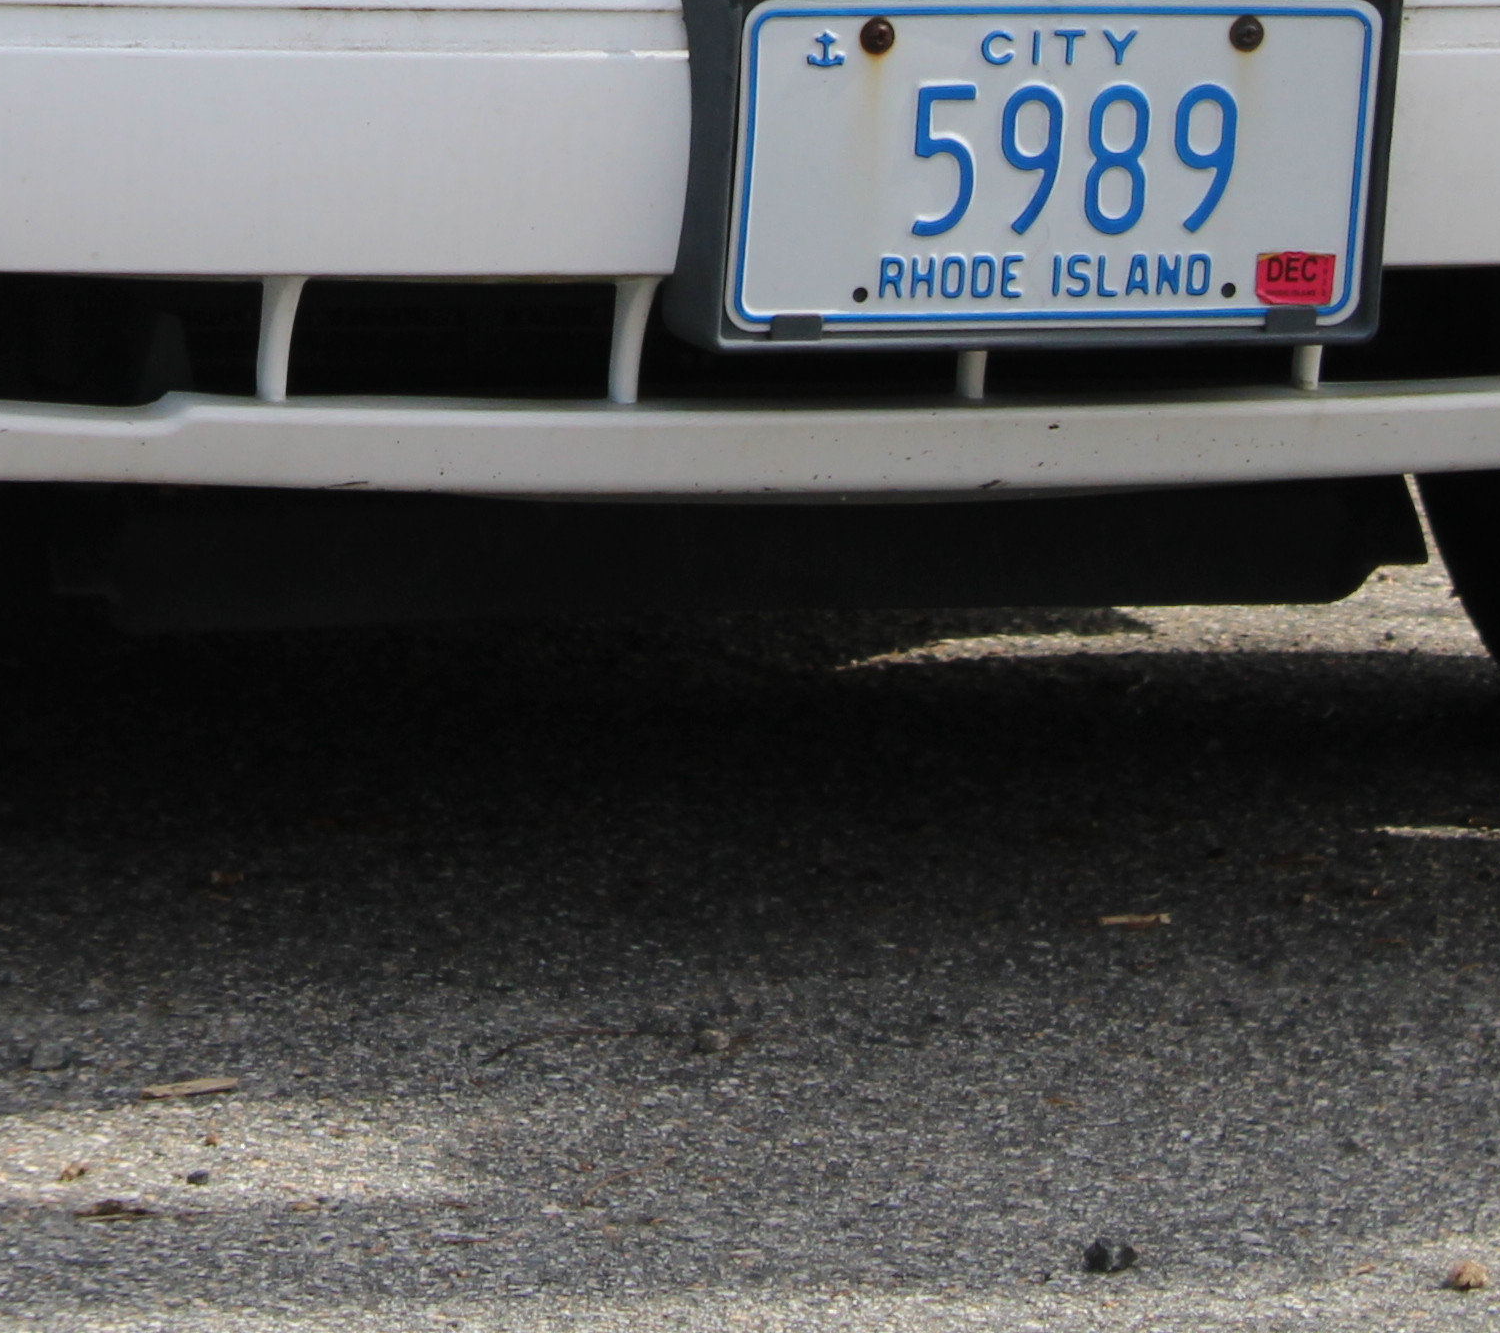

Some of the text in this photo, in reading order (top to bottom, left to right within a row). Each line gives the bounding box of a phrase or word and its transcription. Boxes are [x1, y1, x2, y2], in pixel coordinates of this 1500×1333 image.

[981, 30, 1138, 66] CITY
[911, 83, 1239, 236] 5989
[878, 253, 1213, 299] RHODE ISLAND
[1266, 256, 1318, 282] DEC
